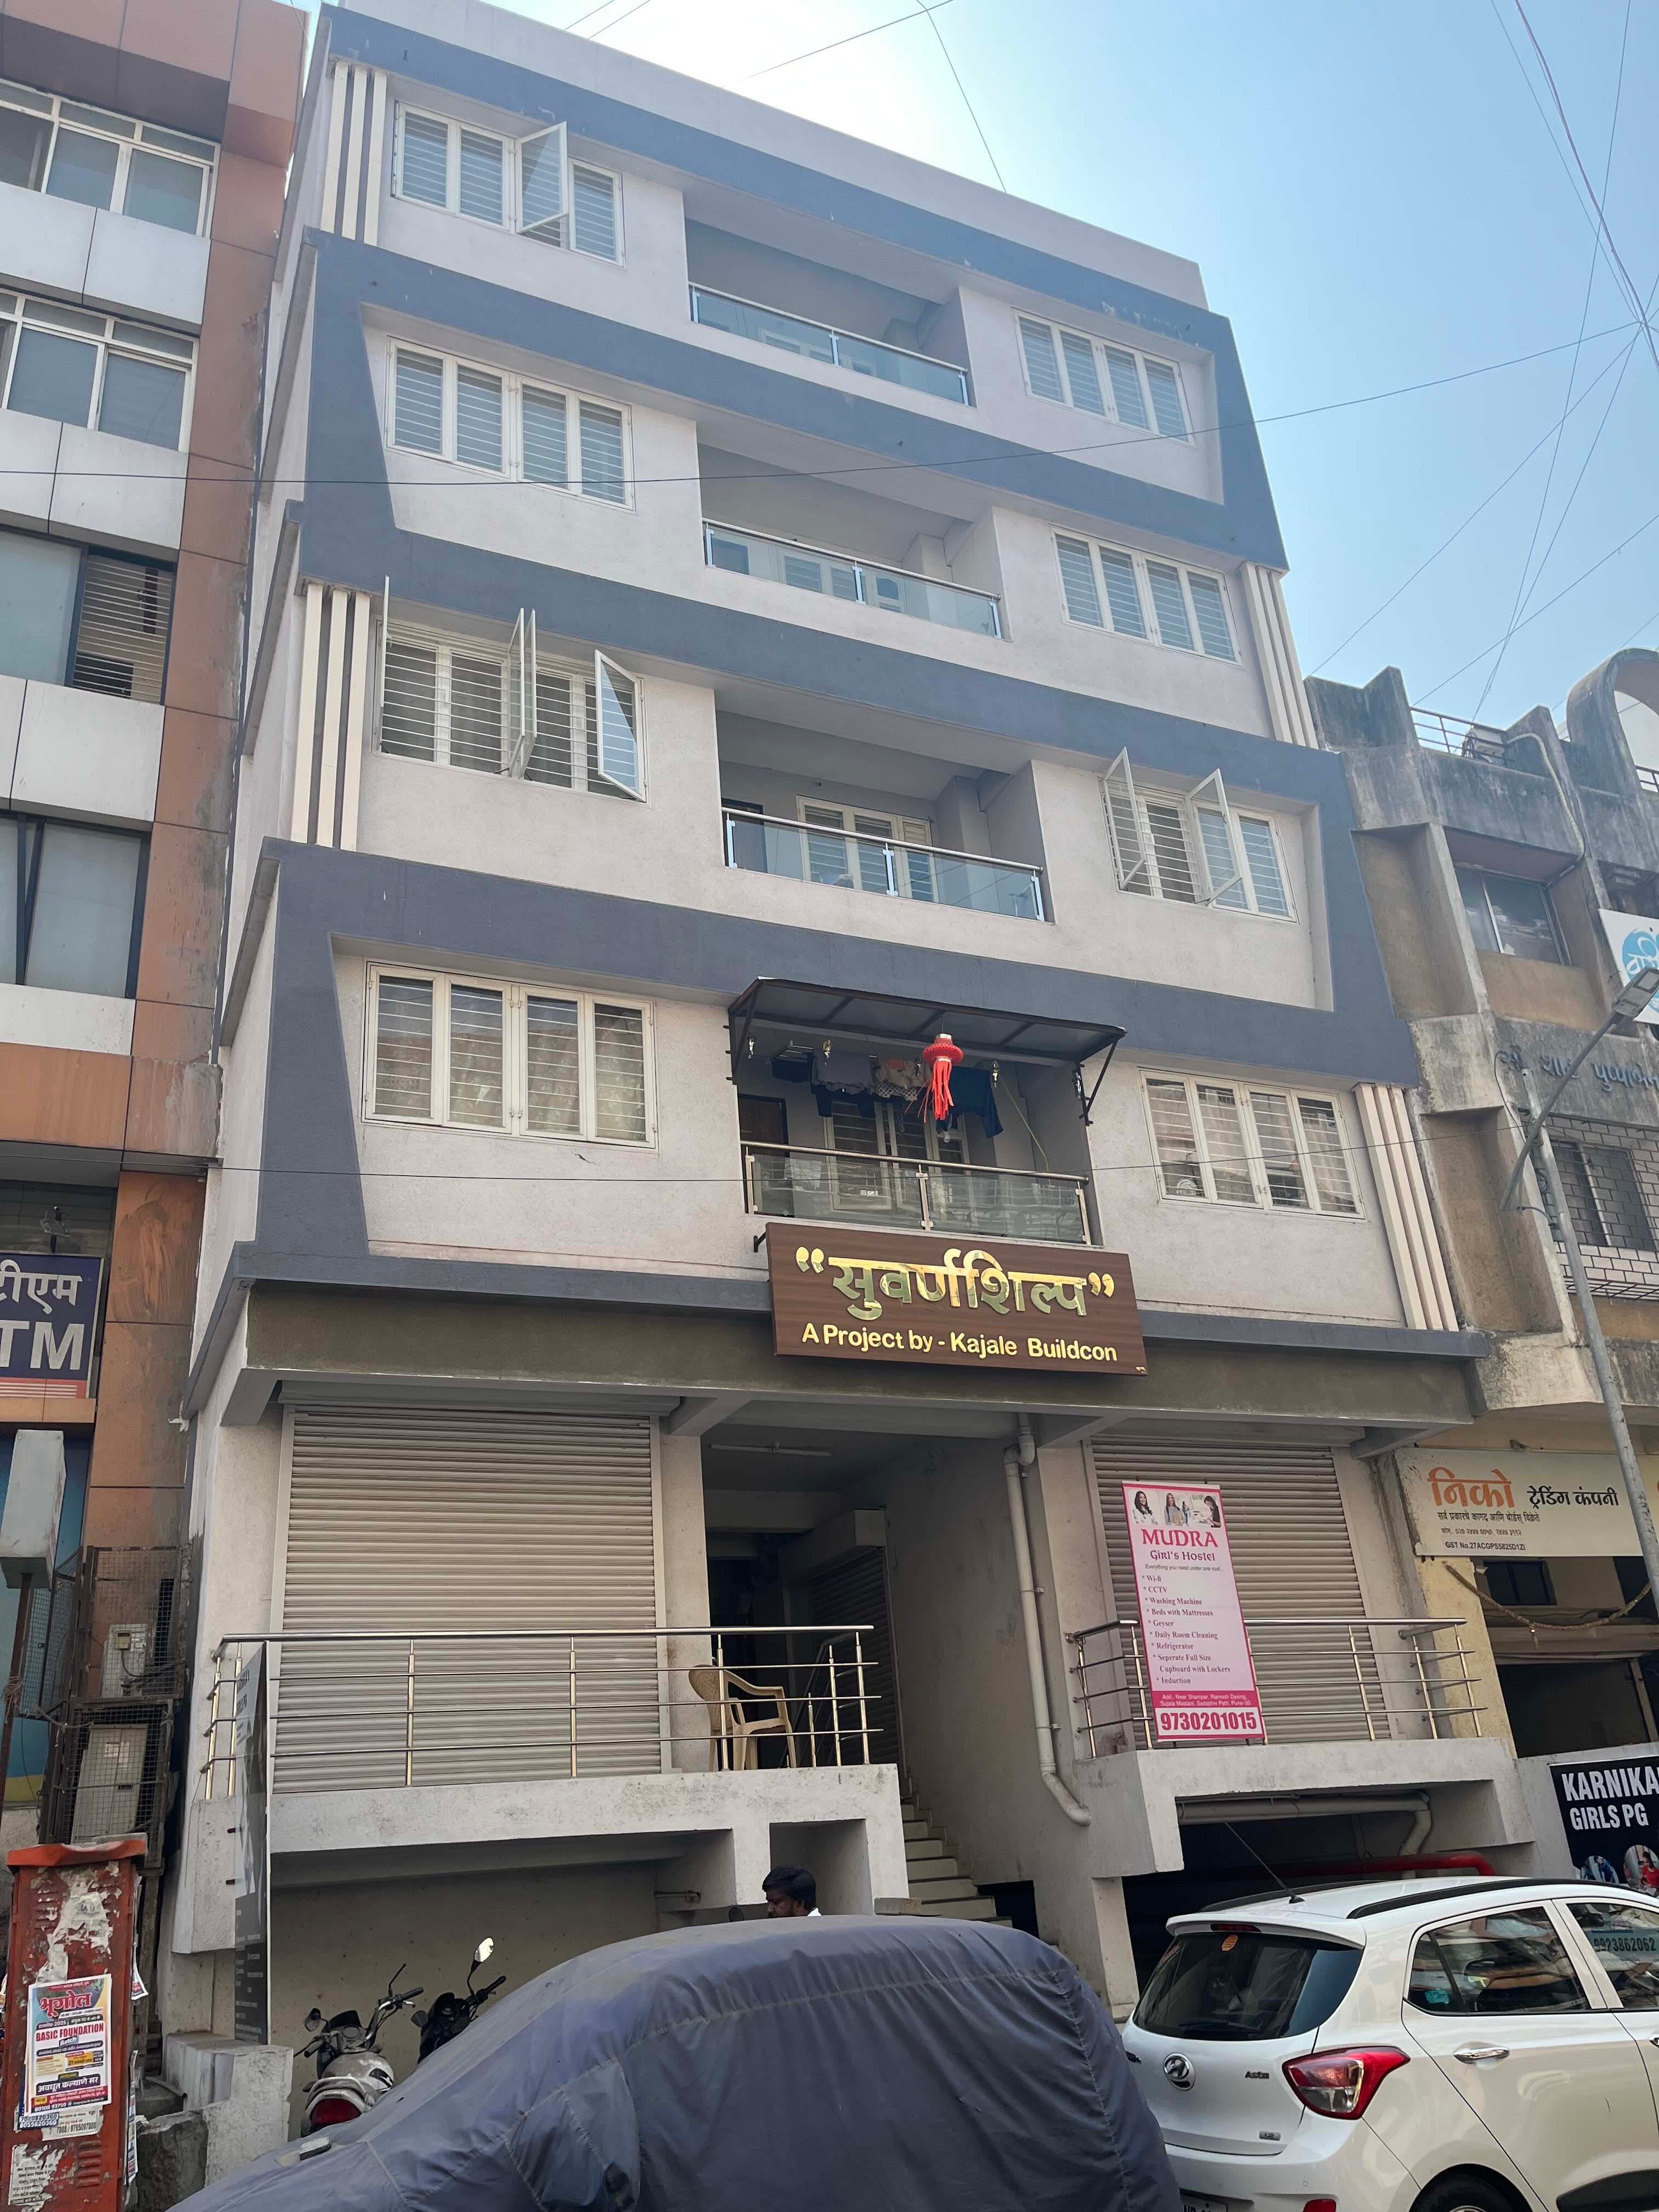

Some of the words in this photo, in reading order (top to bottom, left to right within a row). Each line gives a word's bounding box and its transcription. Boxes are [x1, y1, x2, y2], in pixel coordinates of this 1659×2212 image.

[802, 1322, 820, 1344] A
[823, 1324, 905, 1352] Project
[909, 1329, 933, 1352] by
[950, 1331, 1018, 1359] Kajale
[1028, 1337, 1118, 1361] Buildcon
[1427, 1466, 1515, 1508] निको
[1527, 1485, 1571, 1509] ट्रेडिंग
[1573, 1486, 1620, 1506] कंपनी
[1141, 1528, 1218, 1548] MUDRA
[1182, 1551, 1215, 1561] Hostel
[1150, 1597, 1176, 1605] Washing
[1153, 1620, 1174, 1628] Geyser
[1155, 1631, 1170, 1639] Daily
[1192, 1632, 1218, 1640] Cleaning
[1160, 1665, 1190, 1673] Cupboard
[1160, 1712, 1257, 1730] 9730201015
[1561, 1765, 1659, 1801] KARNIKA
[1570, 1804, 1620, 1830] GIRLS
[1622, 1803, 1649, 1827] PG
[40, 1990, 92, 2018] भूगोल
[36, 2030, 58, 2041] BASIC
[60, 2023, 104, 2038] FOUNDATION
[1245, 2071, 1269, 2079] Asta
